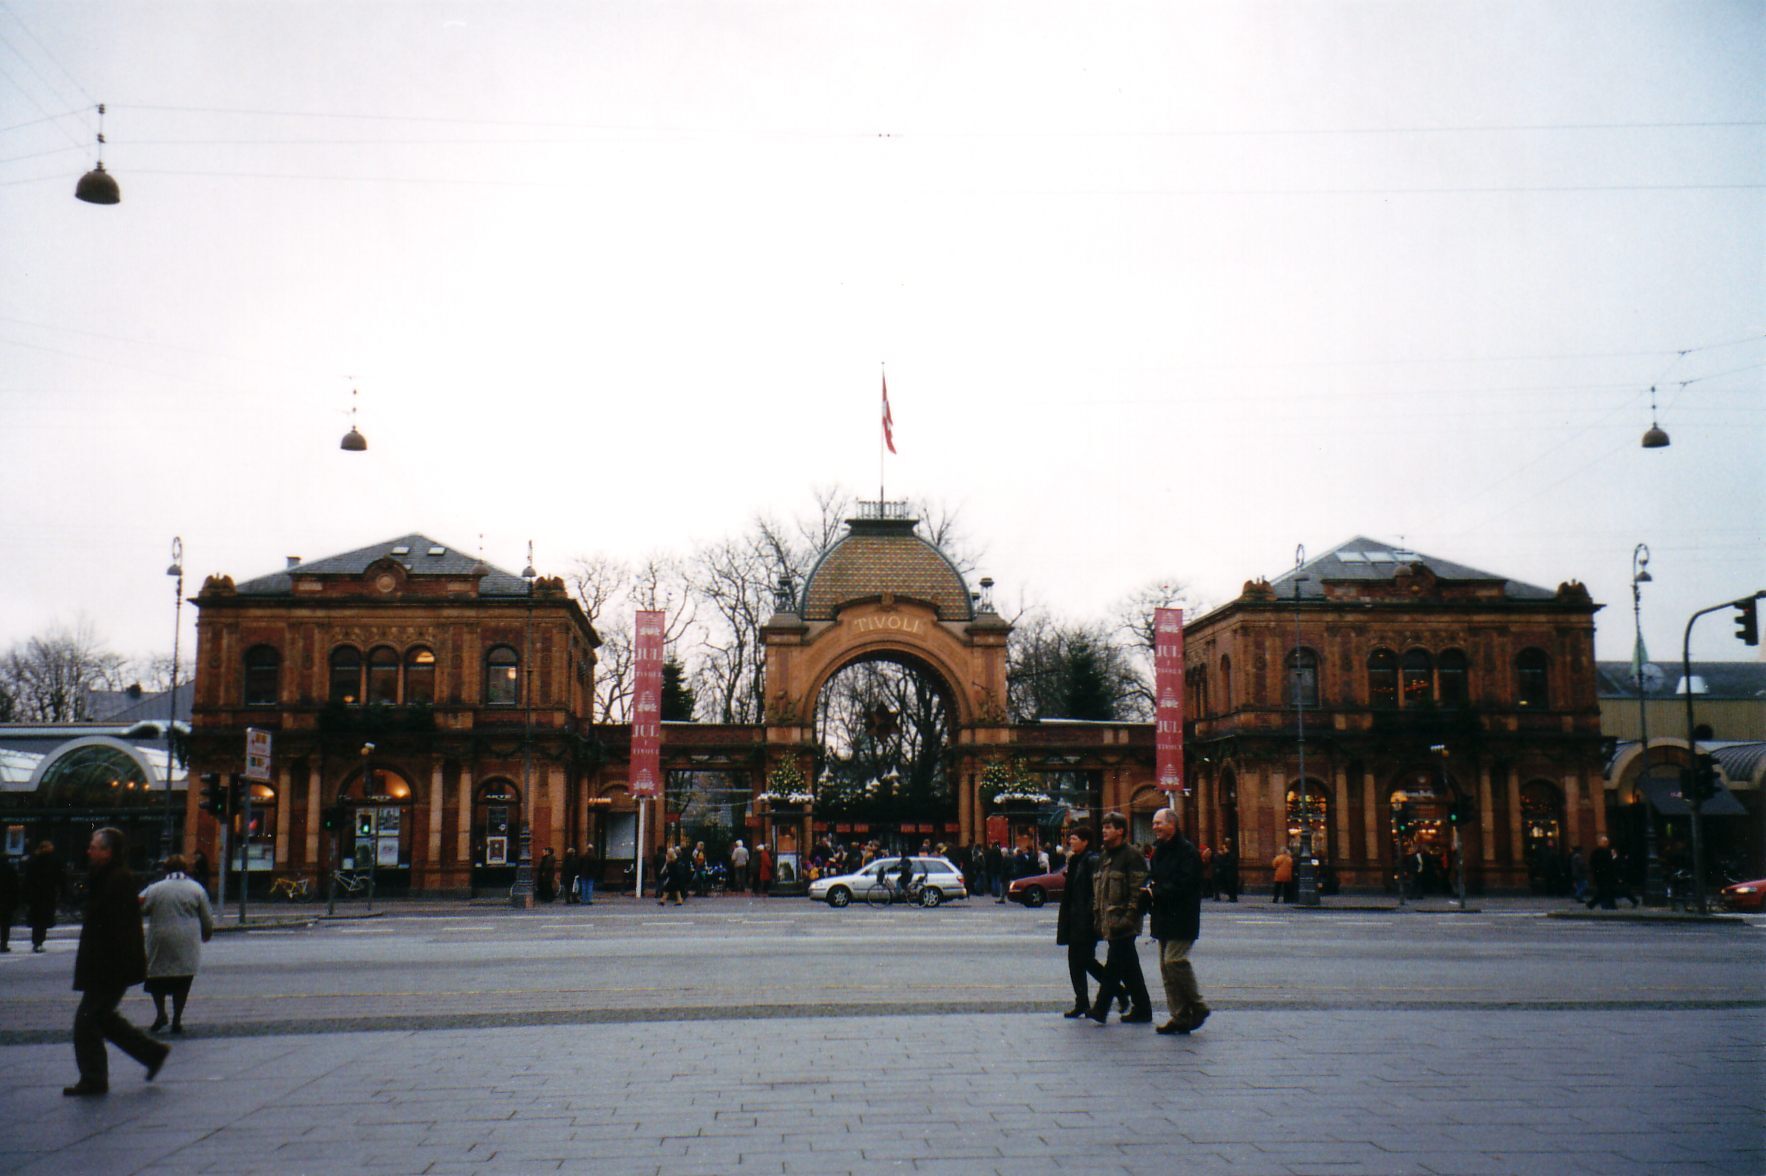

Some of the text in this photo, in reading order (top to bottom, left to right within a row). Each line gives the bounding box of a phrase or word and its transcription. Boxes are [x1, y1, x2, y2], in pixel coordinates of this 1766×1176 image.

[854, 615, 920, 633] TIVOLI
[634, 647, 662, 661] JUL
[1156, 644, 1182, 658] JUL
[632, 724, 660, 737] JUL
[1156, 720, 1182, 733] JUL
